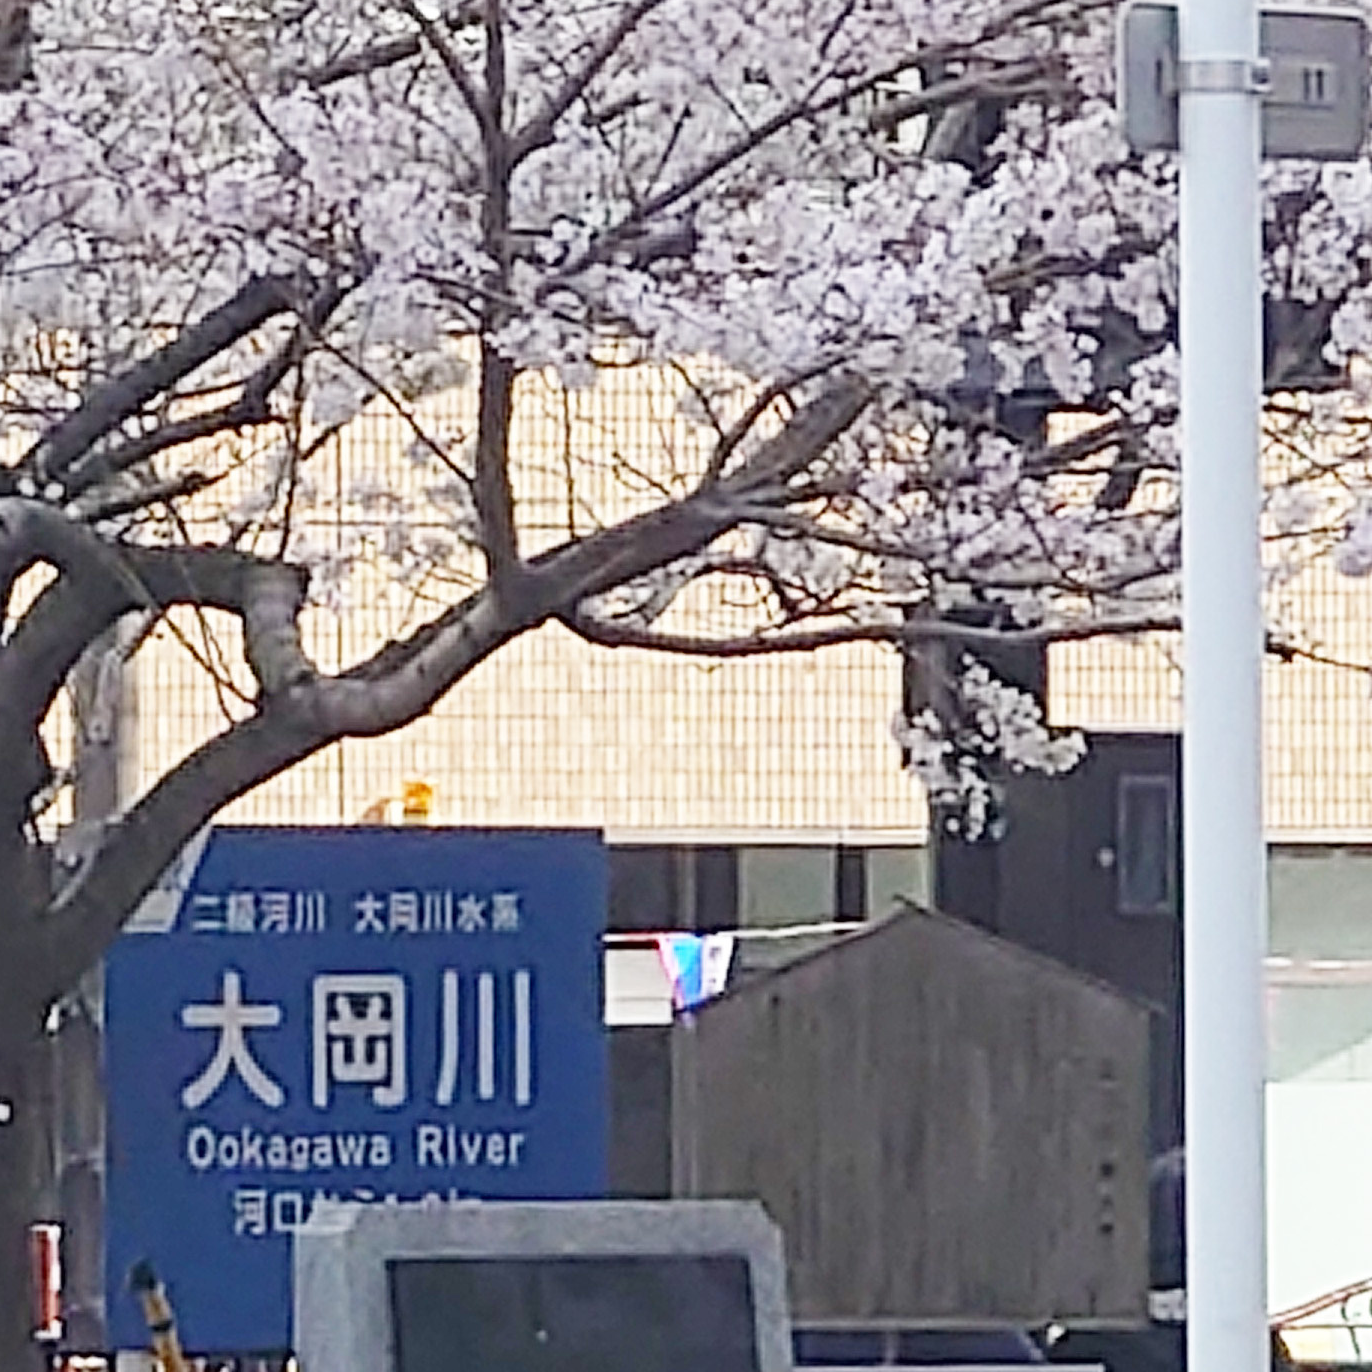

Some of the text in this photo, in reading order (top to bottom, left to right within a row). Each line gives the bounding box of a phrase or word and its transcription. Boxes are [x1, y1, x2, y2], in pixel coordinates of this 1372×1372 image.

[181, 969, 531, 1108] 大岡川
[188, 1125, 525, 1169] Ookagawa River
